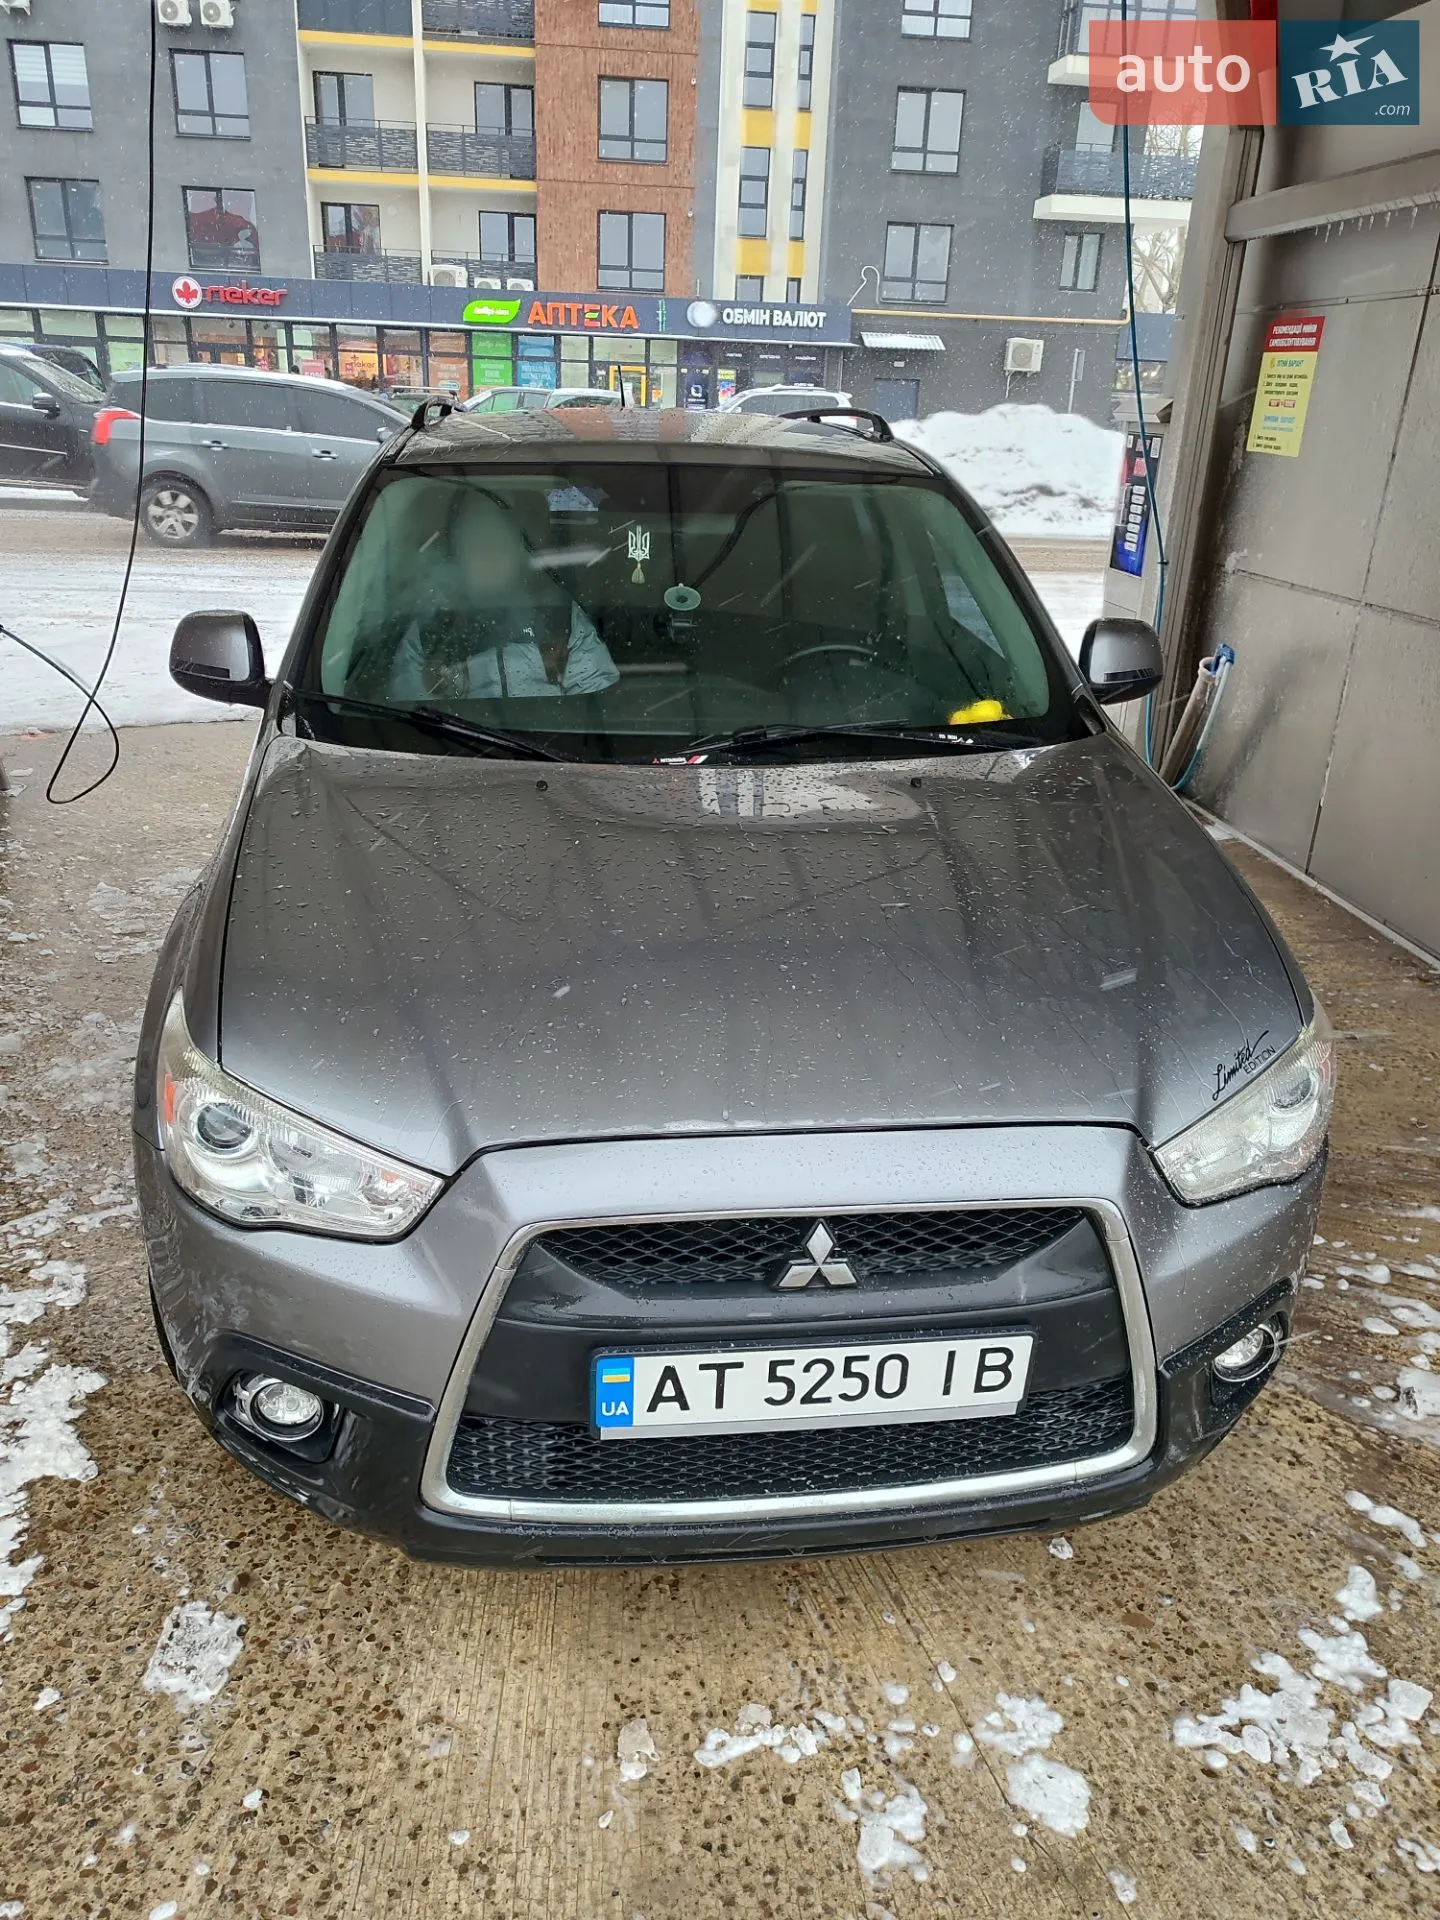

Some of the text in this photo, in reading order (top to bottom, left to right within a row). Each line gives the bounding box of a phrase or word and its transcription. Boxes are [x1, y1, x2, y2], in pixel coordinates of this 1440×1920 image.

[206, 279, 288, 306] rieker
[527, 300, 640, 329] АПТЕКА
[722, 307, 827, 328] ОБМІН ВАЛЮТ
[1212, 1029, 1270, 1101] Limited
[1243, 1045, 1277, 1075] EDITION
[646, 1346, 1015, 1413] AT 5250 IB
[601, 1402, 630, 1417] UA
